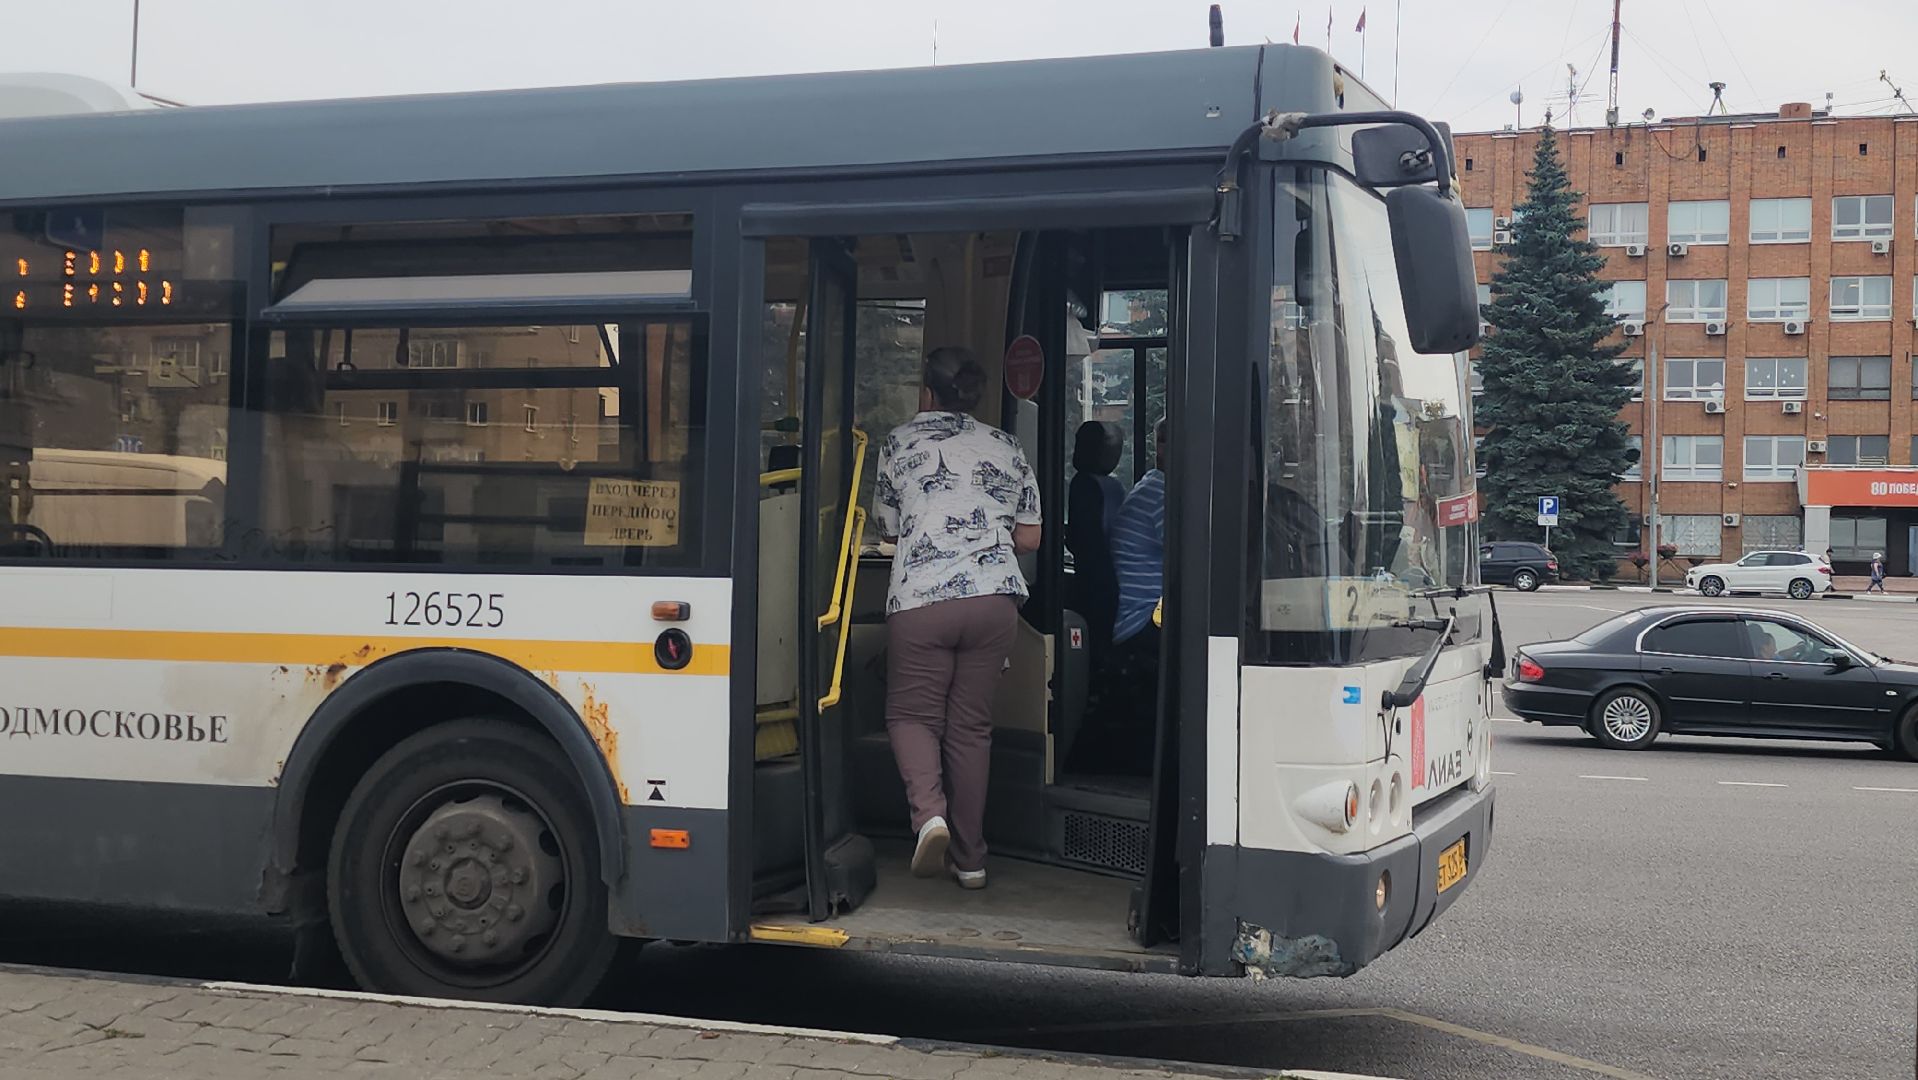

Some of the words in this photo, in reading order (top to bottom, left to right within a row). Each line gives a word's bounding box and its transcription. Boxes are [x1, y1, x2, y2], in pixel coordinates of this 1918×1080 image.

[1889, 482, 1918, 496] ПОБЕ
[1542, 498, 1554, 514] P
[384, 591, 505, 628] 126525
